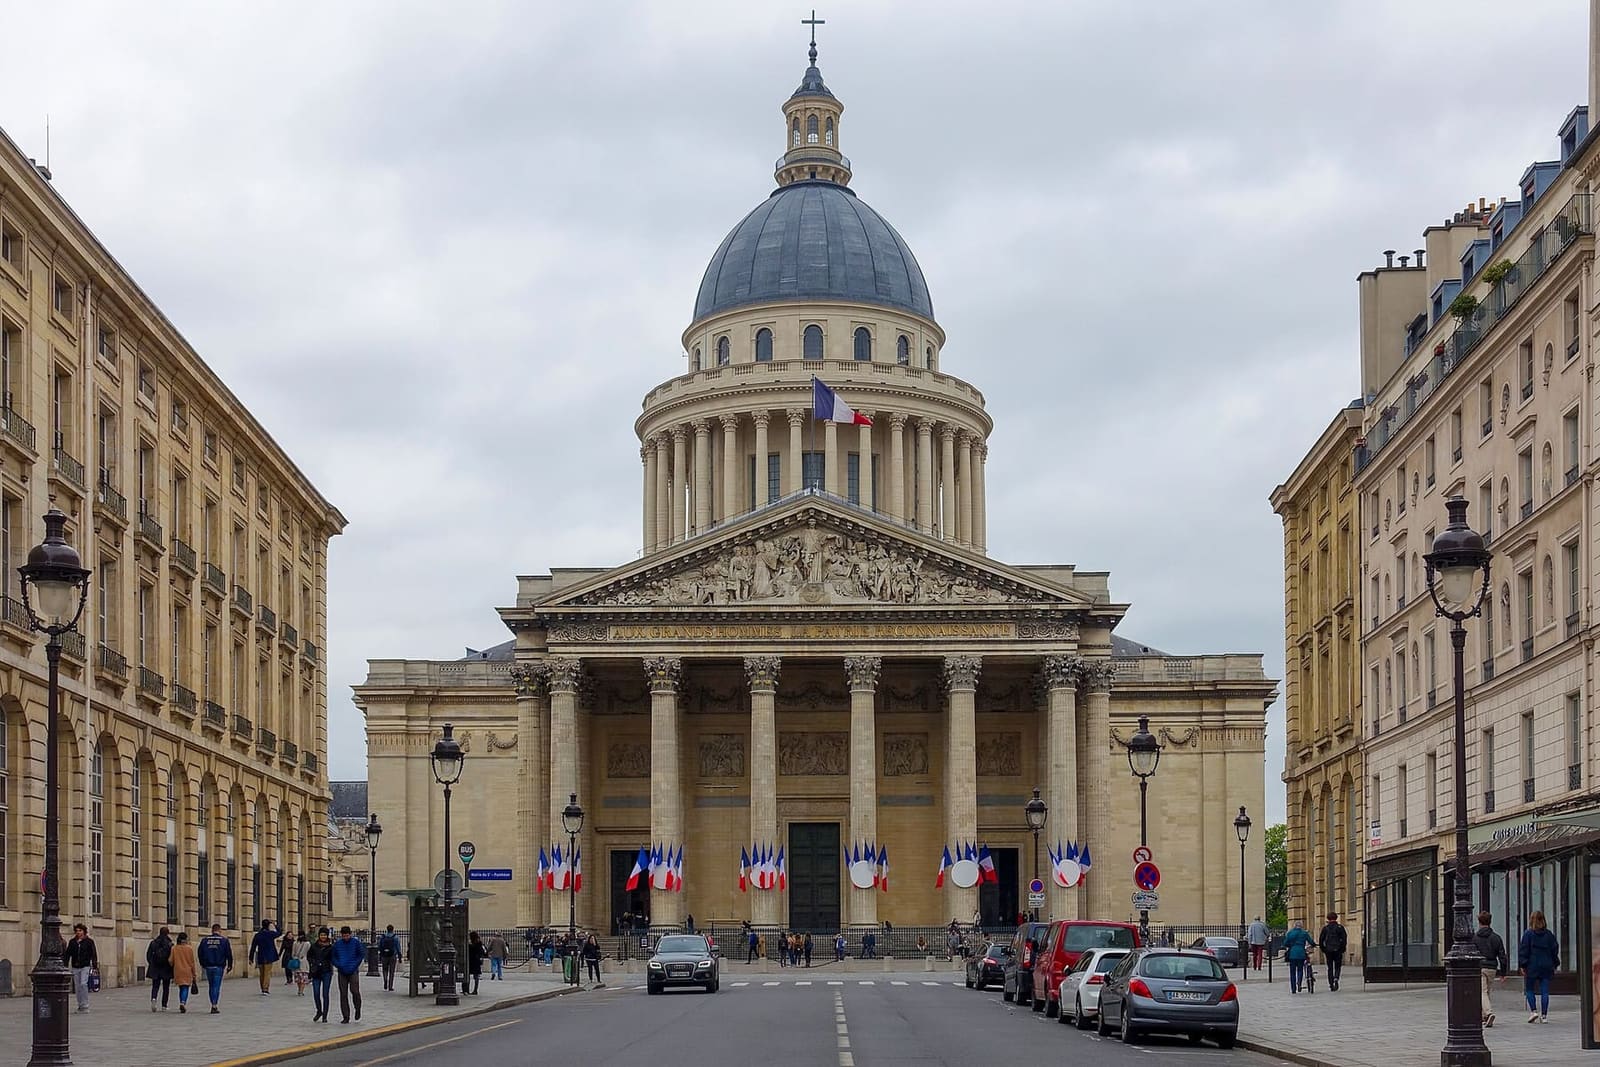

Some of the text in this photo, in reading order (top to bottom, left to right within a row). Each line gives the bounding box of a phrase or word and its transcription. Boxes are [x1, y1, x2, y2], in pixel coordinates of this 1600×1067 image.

[612, 624, 1011, 638] AUX GRANDS HOMMES LA PATRIE RECONNAISSANTE
